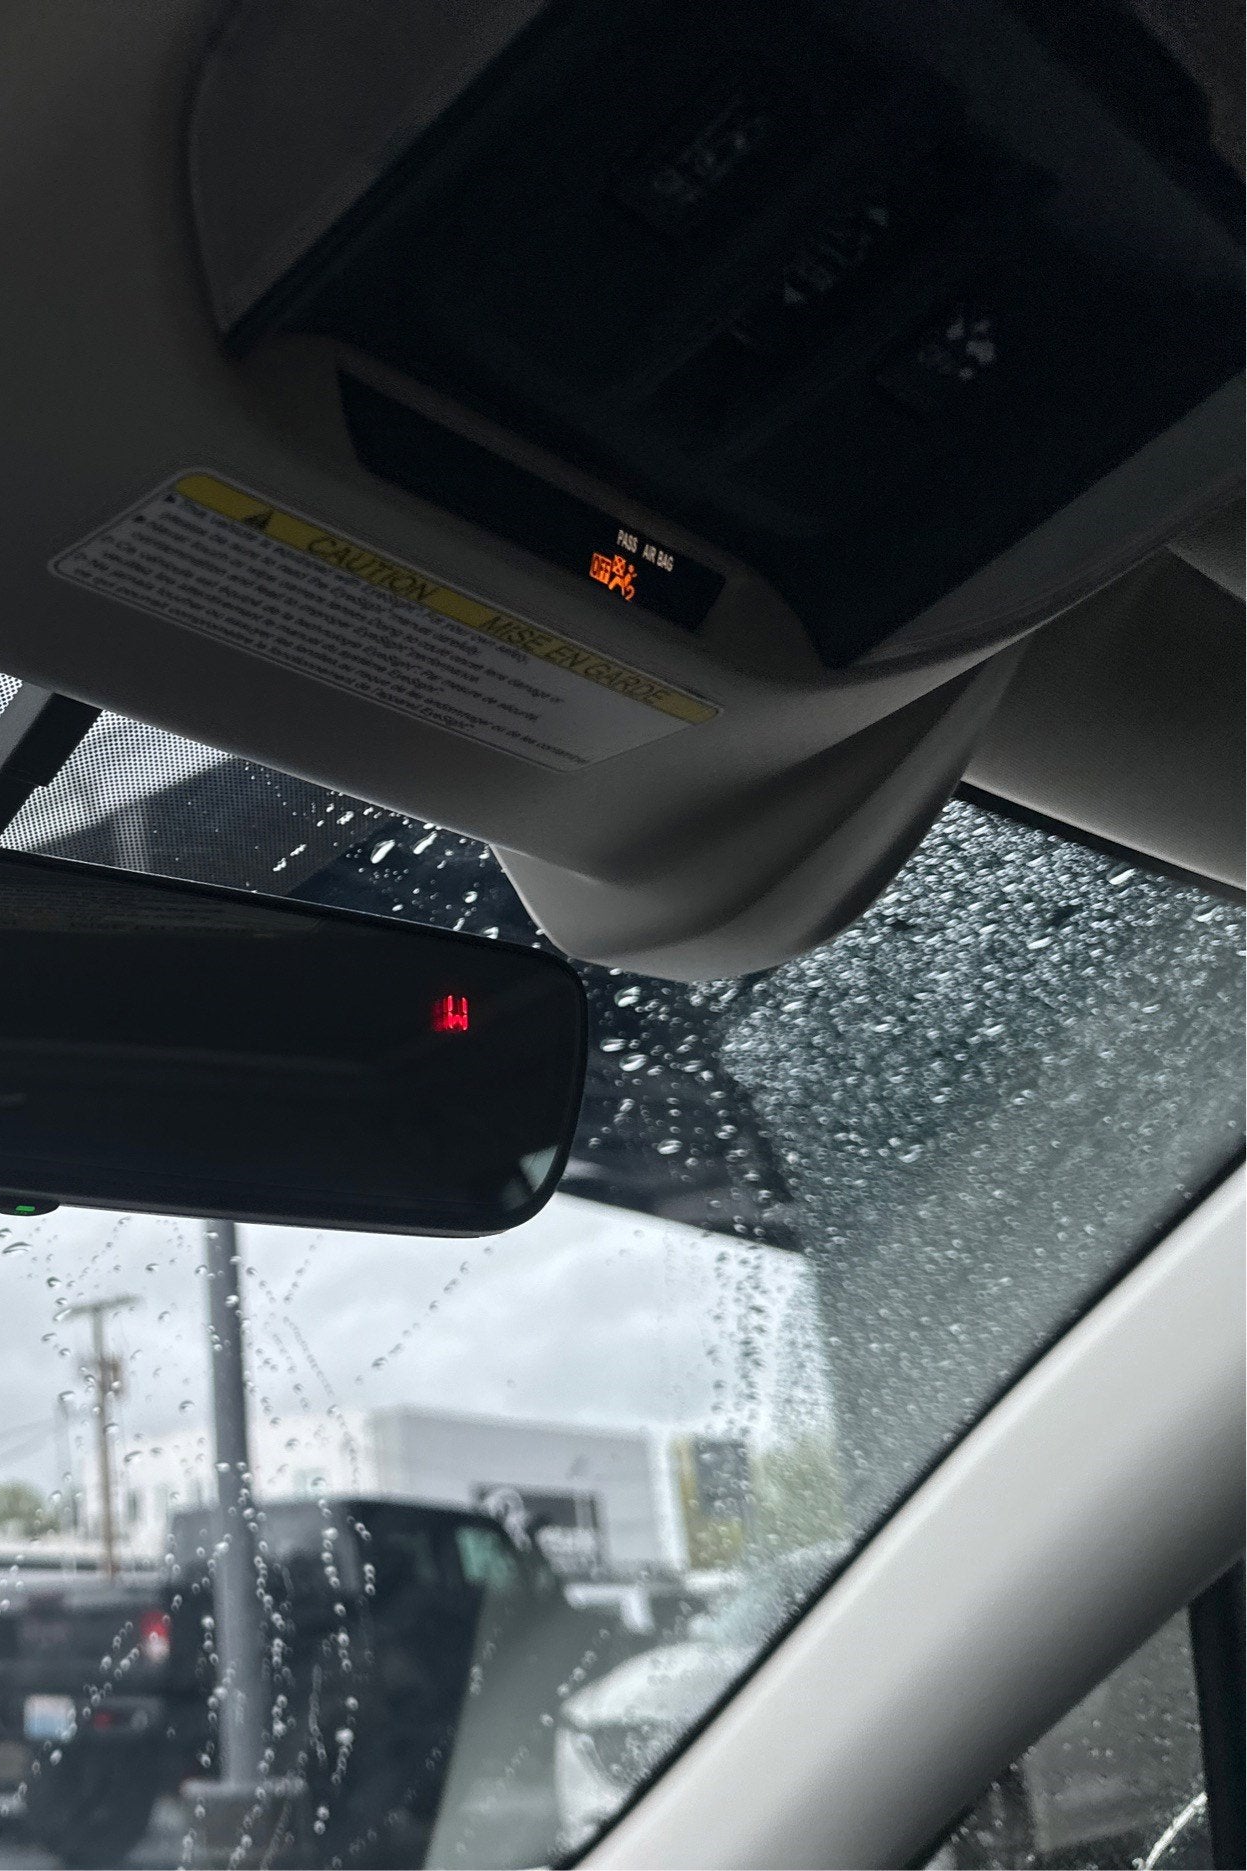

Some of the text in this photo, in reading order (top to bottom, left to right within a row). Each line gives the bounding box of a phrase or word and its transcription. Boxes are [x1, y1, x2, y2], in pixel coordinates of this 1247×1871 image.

[617, 530, 674, 572] PASS AIR BAG
[299, 535, 442, 601] CAUTION
[475, 614, 552, 651] MISE
[541, 644, 594, 669] EN
[577, 660, 674, 704] GARDE
